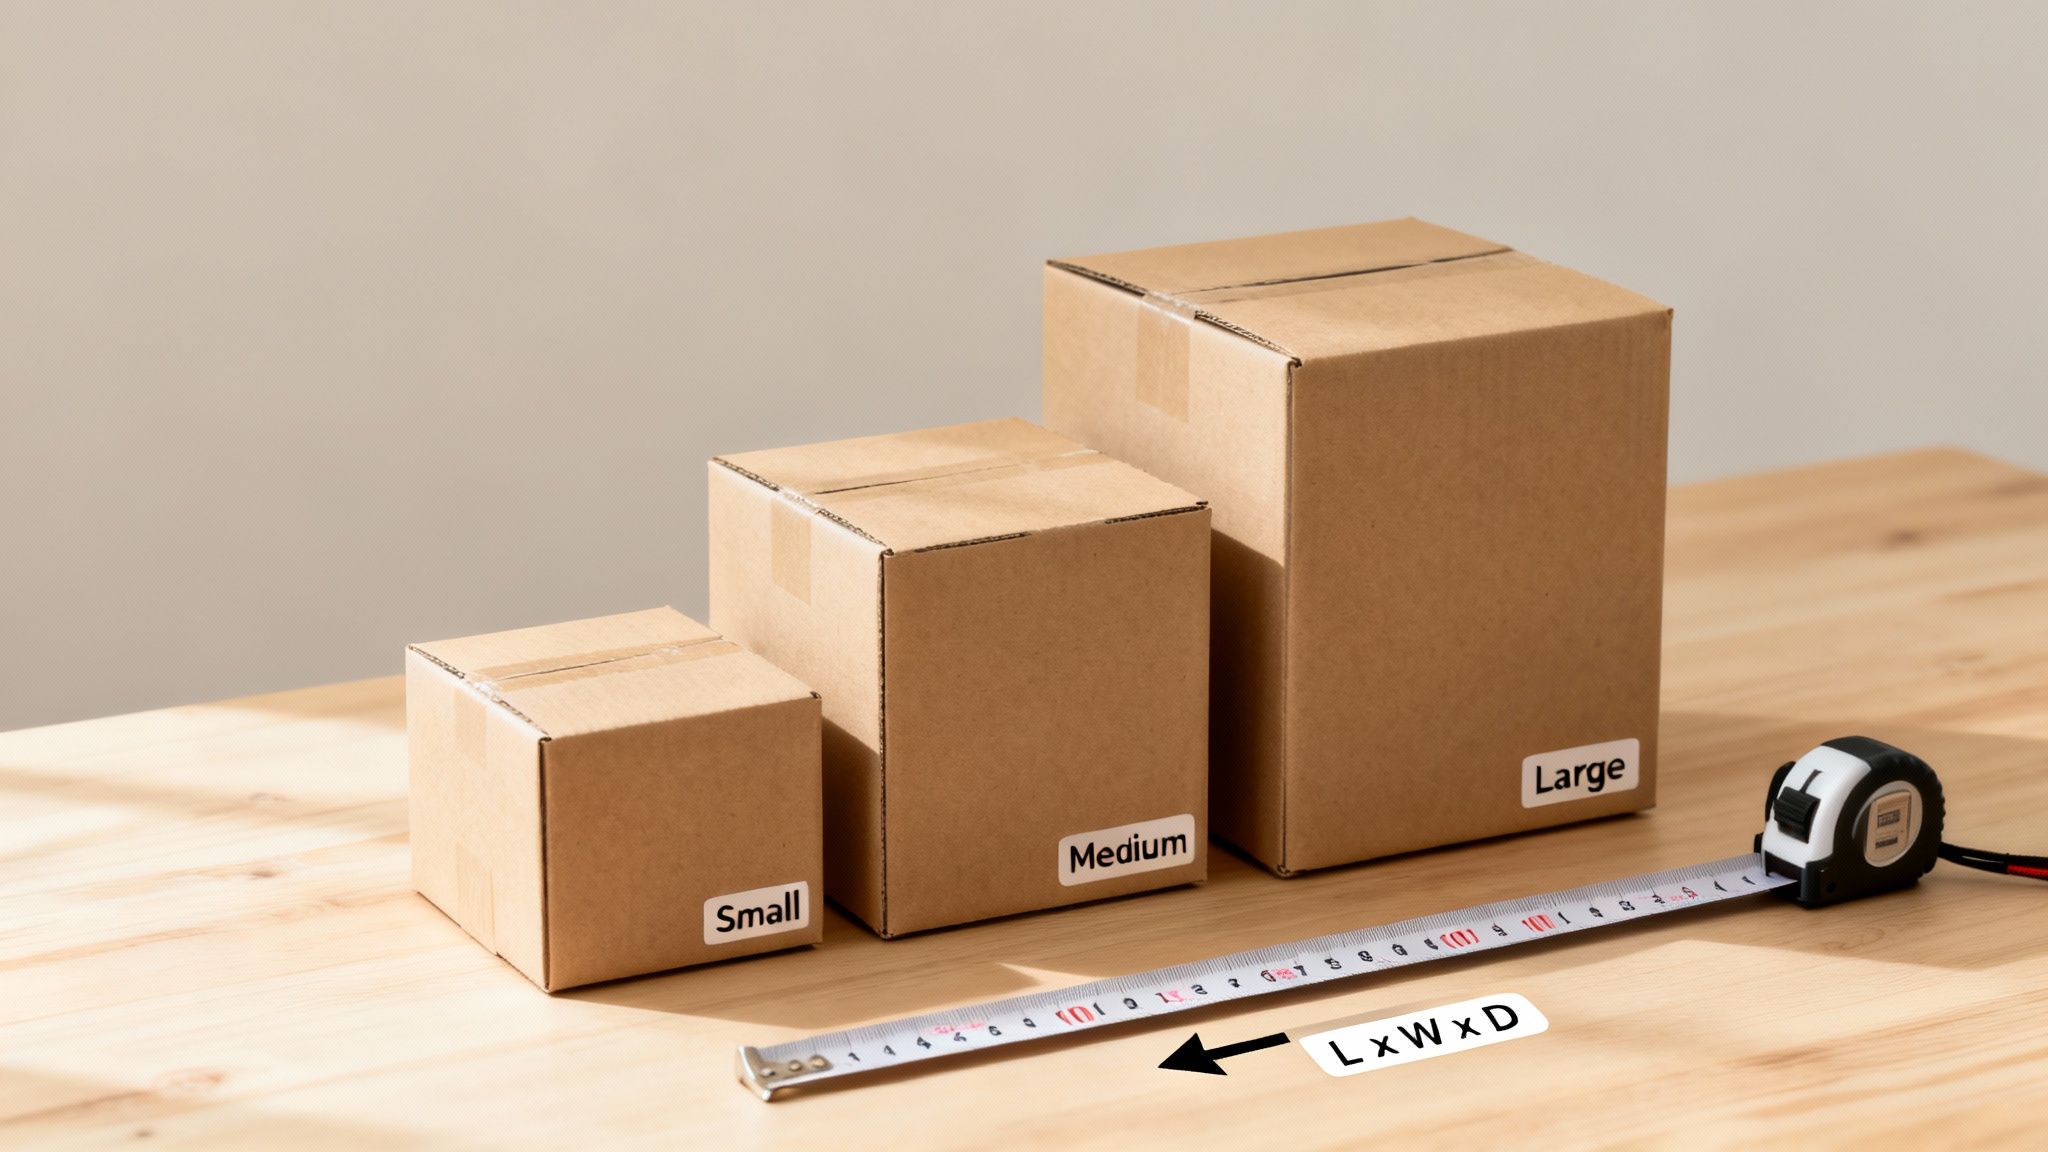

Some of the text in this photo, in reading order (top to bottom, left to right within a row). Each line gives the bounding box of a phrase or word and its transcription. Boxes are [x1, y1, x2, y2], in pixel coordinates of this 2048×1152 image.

[1536, 758, 1625, 794] Large
[1070, 833, 1187, 873] Medium
[716, 889, 800, 932] Small
[1328, 1004, 1519, 1066] L x W x D
